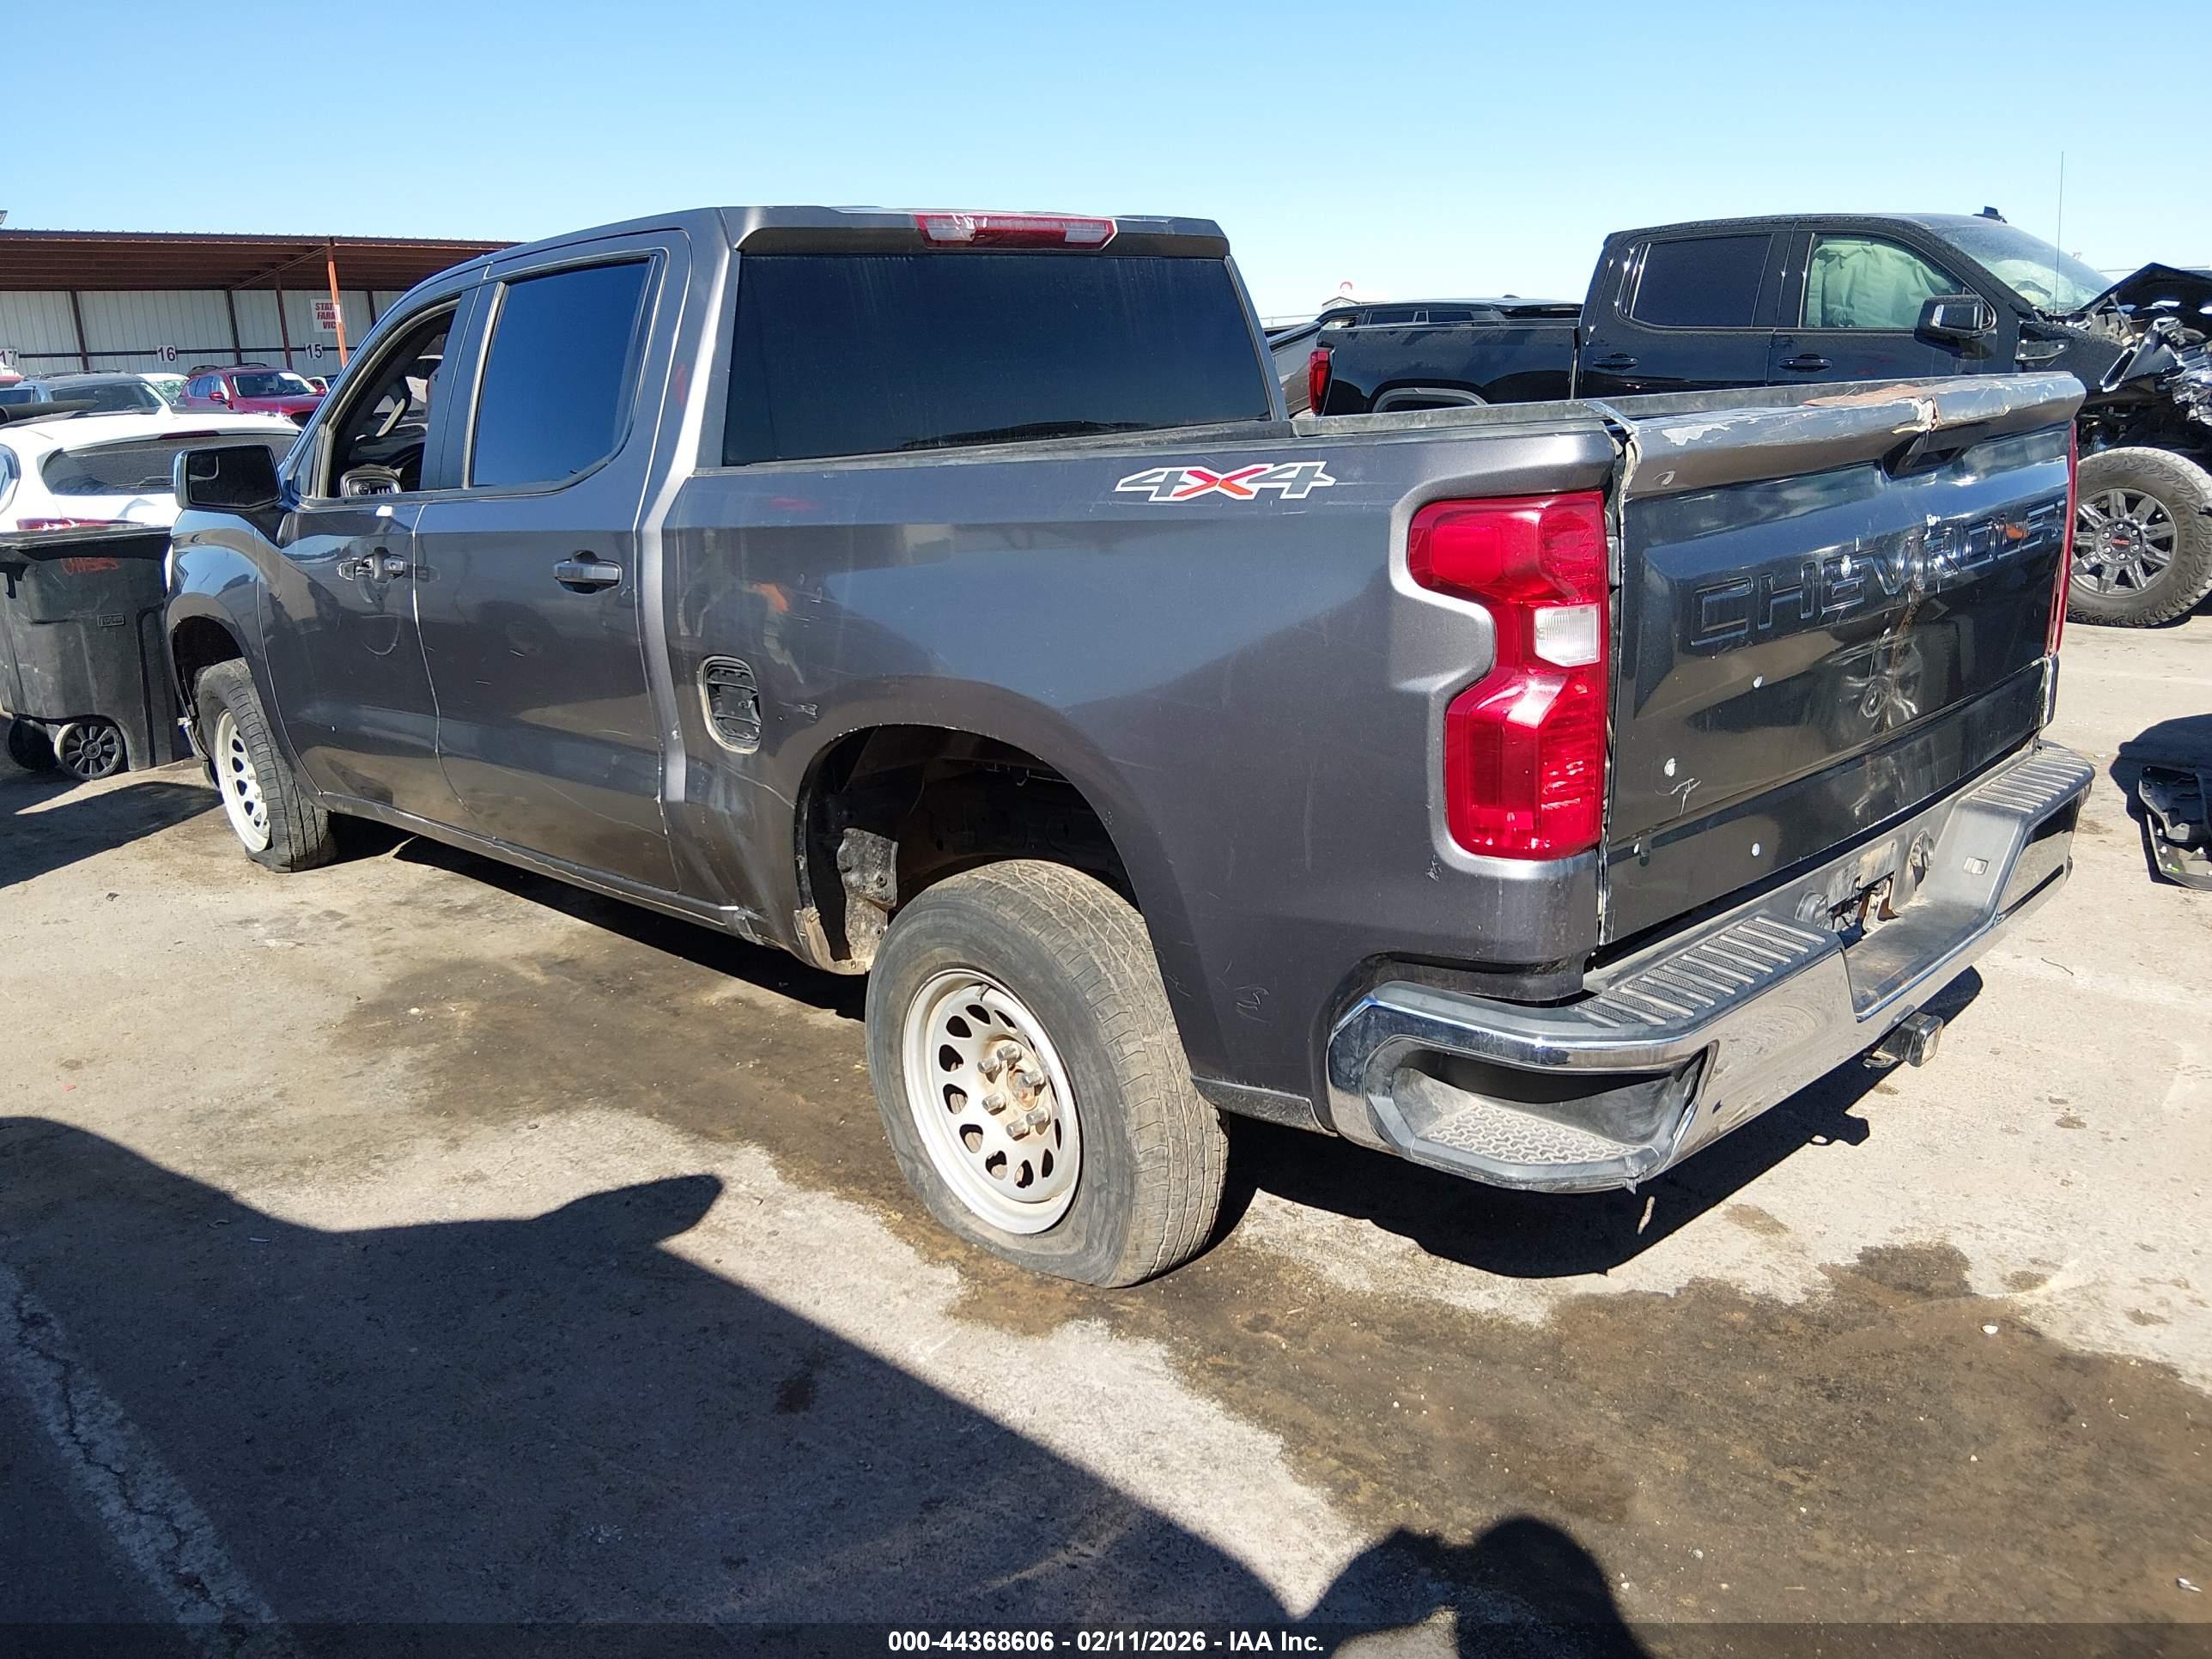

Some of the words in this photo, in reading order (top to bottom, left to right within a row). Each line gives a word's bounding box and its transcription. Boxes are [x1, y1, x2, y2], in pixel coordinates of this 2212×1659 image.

[315, 302, 335, 311] STAT
[157, 346, 176, 362] 16
[307, 343, 323, 359] 15
